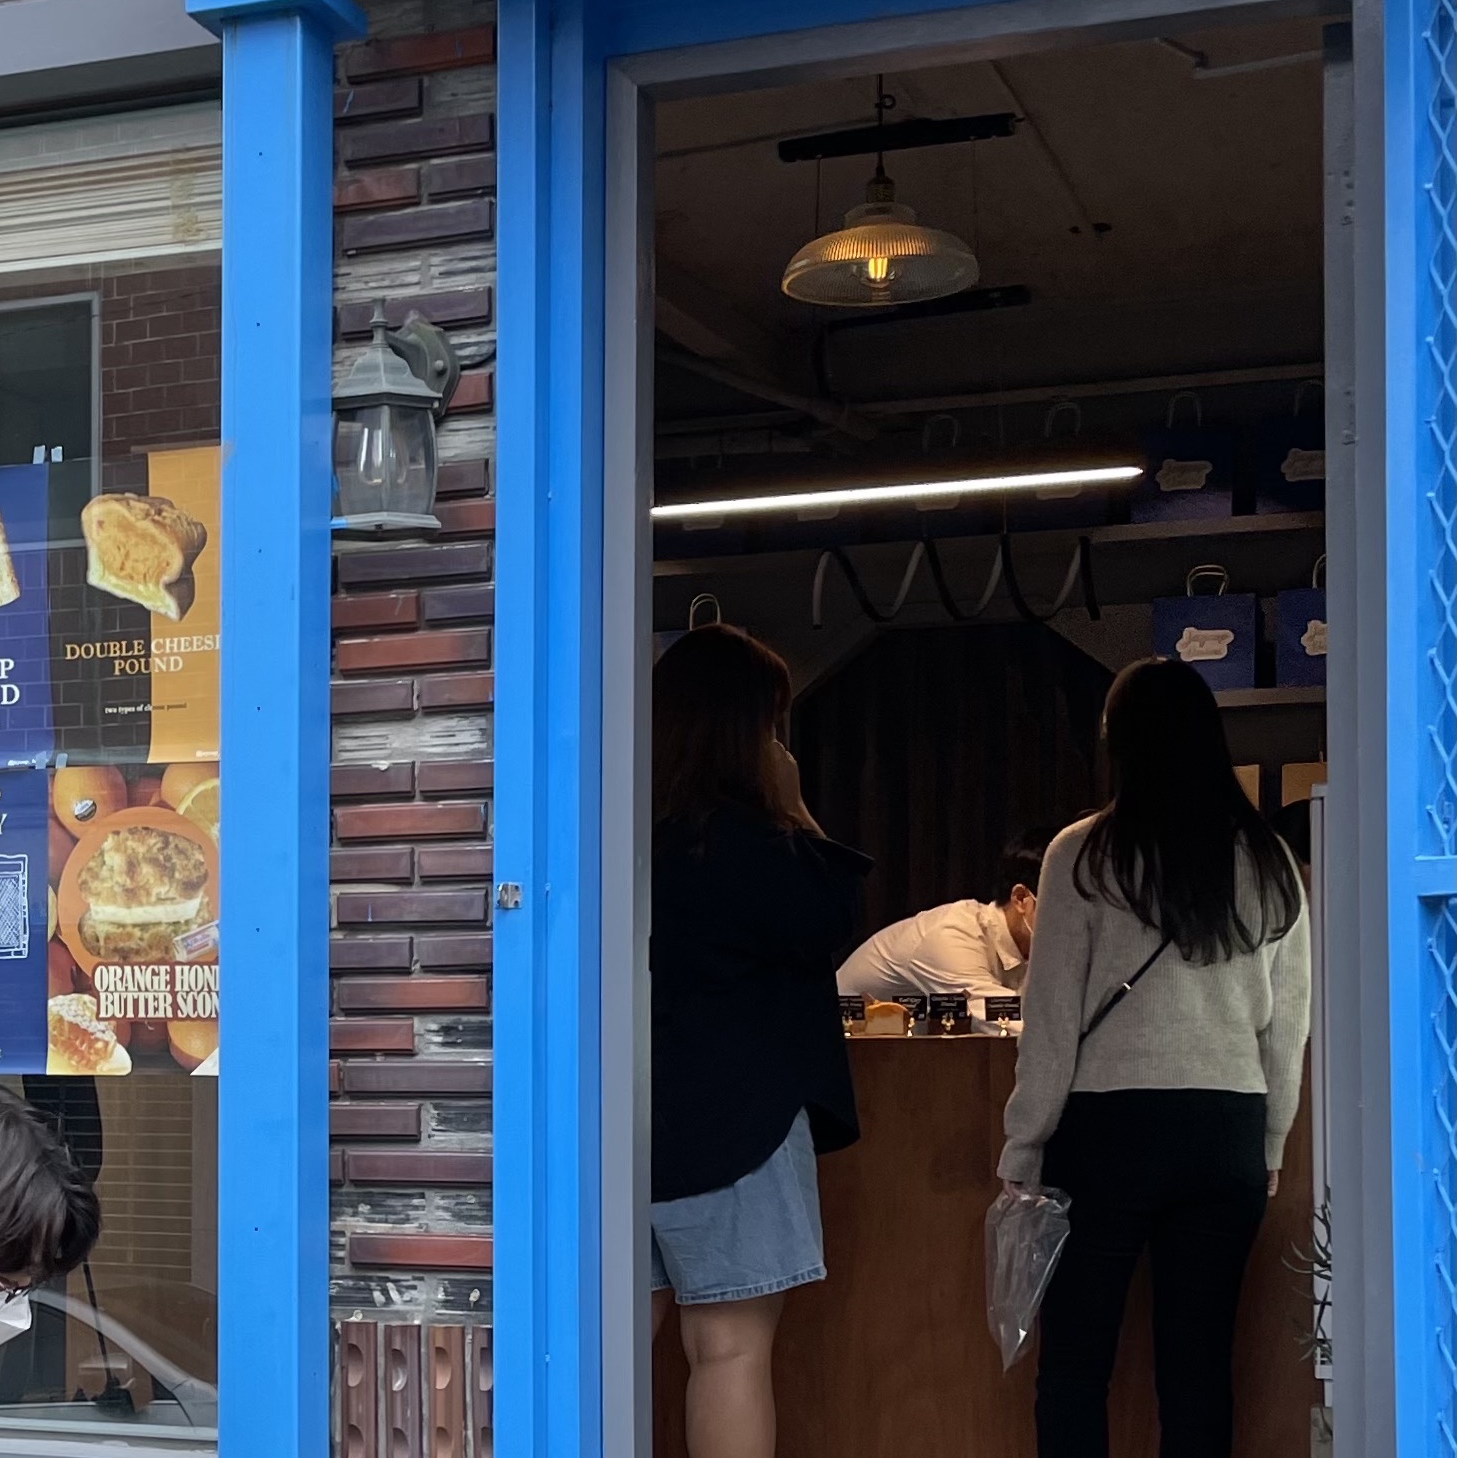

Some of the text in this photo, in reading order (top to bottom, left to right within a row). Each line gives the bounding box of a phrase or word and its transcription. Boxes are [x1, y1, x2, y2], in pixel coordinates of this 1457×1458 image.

[65, 639, 144, 660] DOUBLE
[113, 656, 183, 676] POUND
[94, 965, 171, 992] ORANGE
[99, 991, 173, 1019] BUTTER
